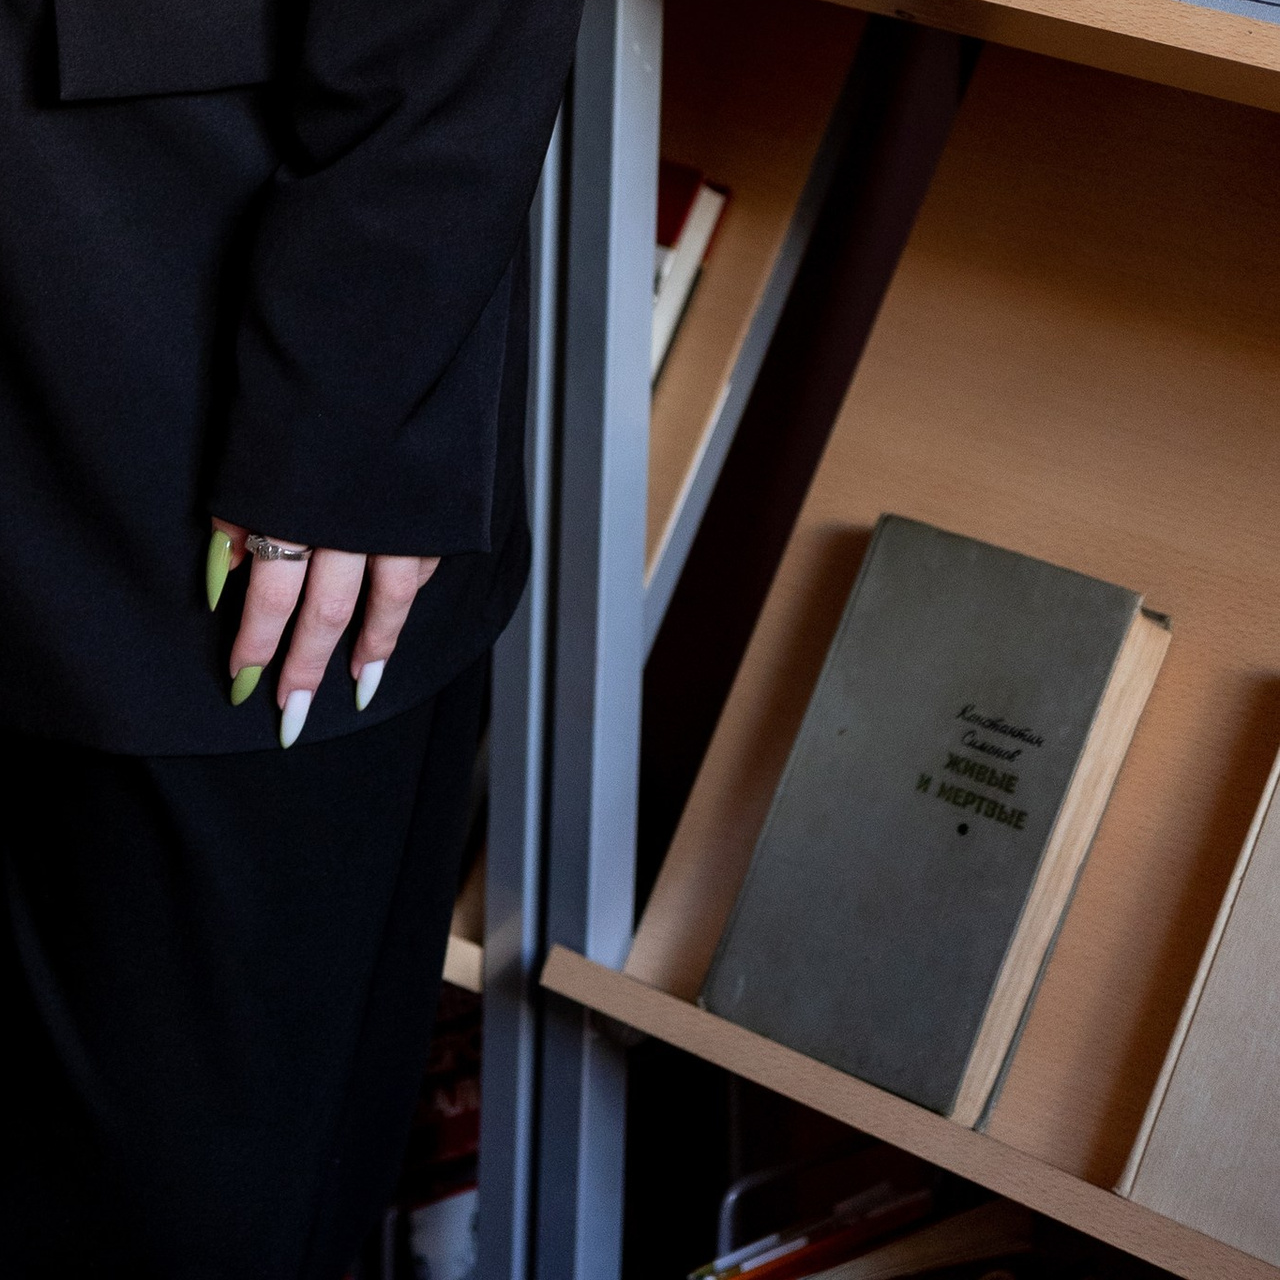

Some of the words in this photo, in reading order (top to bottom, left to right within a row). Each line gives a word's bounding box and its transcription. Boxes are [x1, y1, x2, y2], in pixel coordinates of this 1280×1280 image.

[956, 703, 1045, 747] Константин
[962, 729, 1022, 762] Симонов
[944, 751, 1020, 794] ЖИВЫЕ
[915, 772, 933, 793] И
[936, 781, 1028, 830] МЕРТВЫЕ
